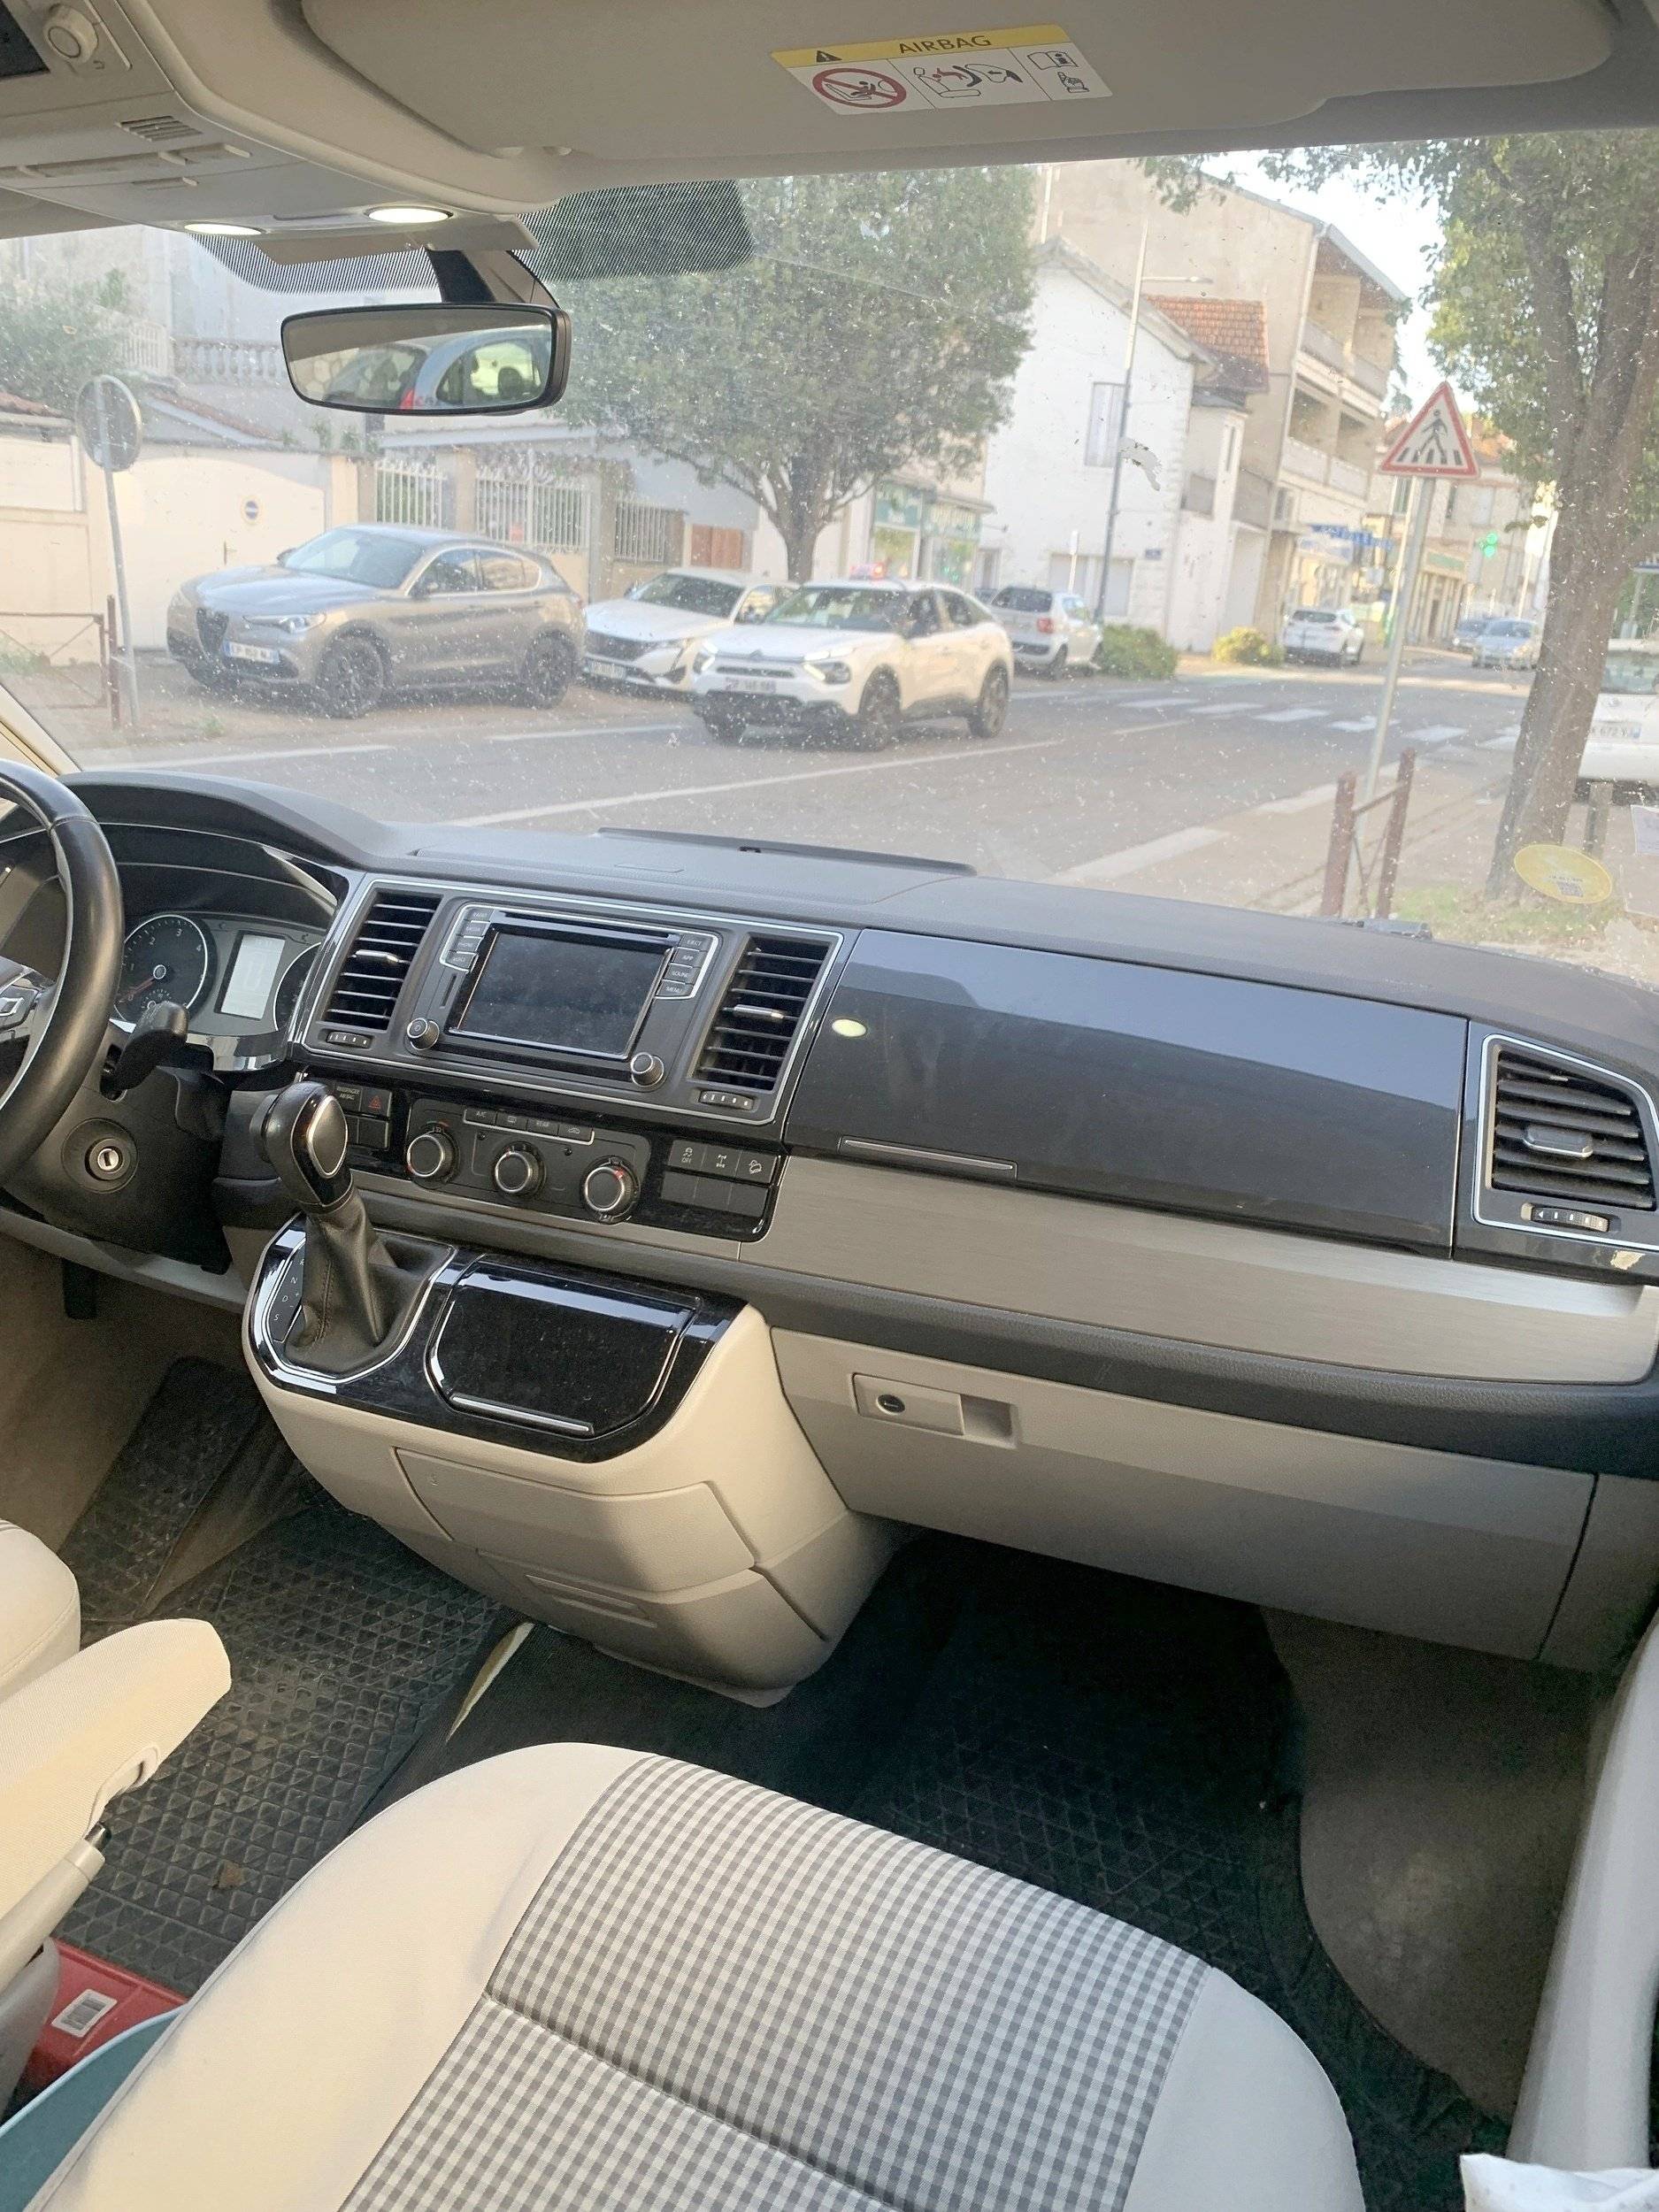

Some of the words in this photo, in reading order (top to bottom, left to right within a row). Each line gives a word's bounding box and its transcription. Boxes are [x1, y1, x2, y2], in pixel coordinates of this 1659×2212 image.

[899, 35, 992, 54] AIRBAG
[176, 928, 182, 937] 3
[149, 937, 156, 946] 2
